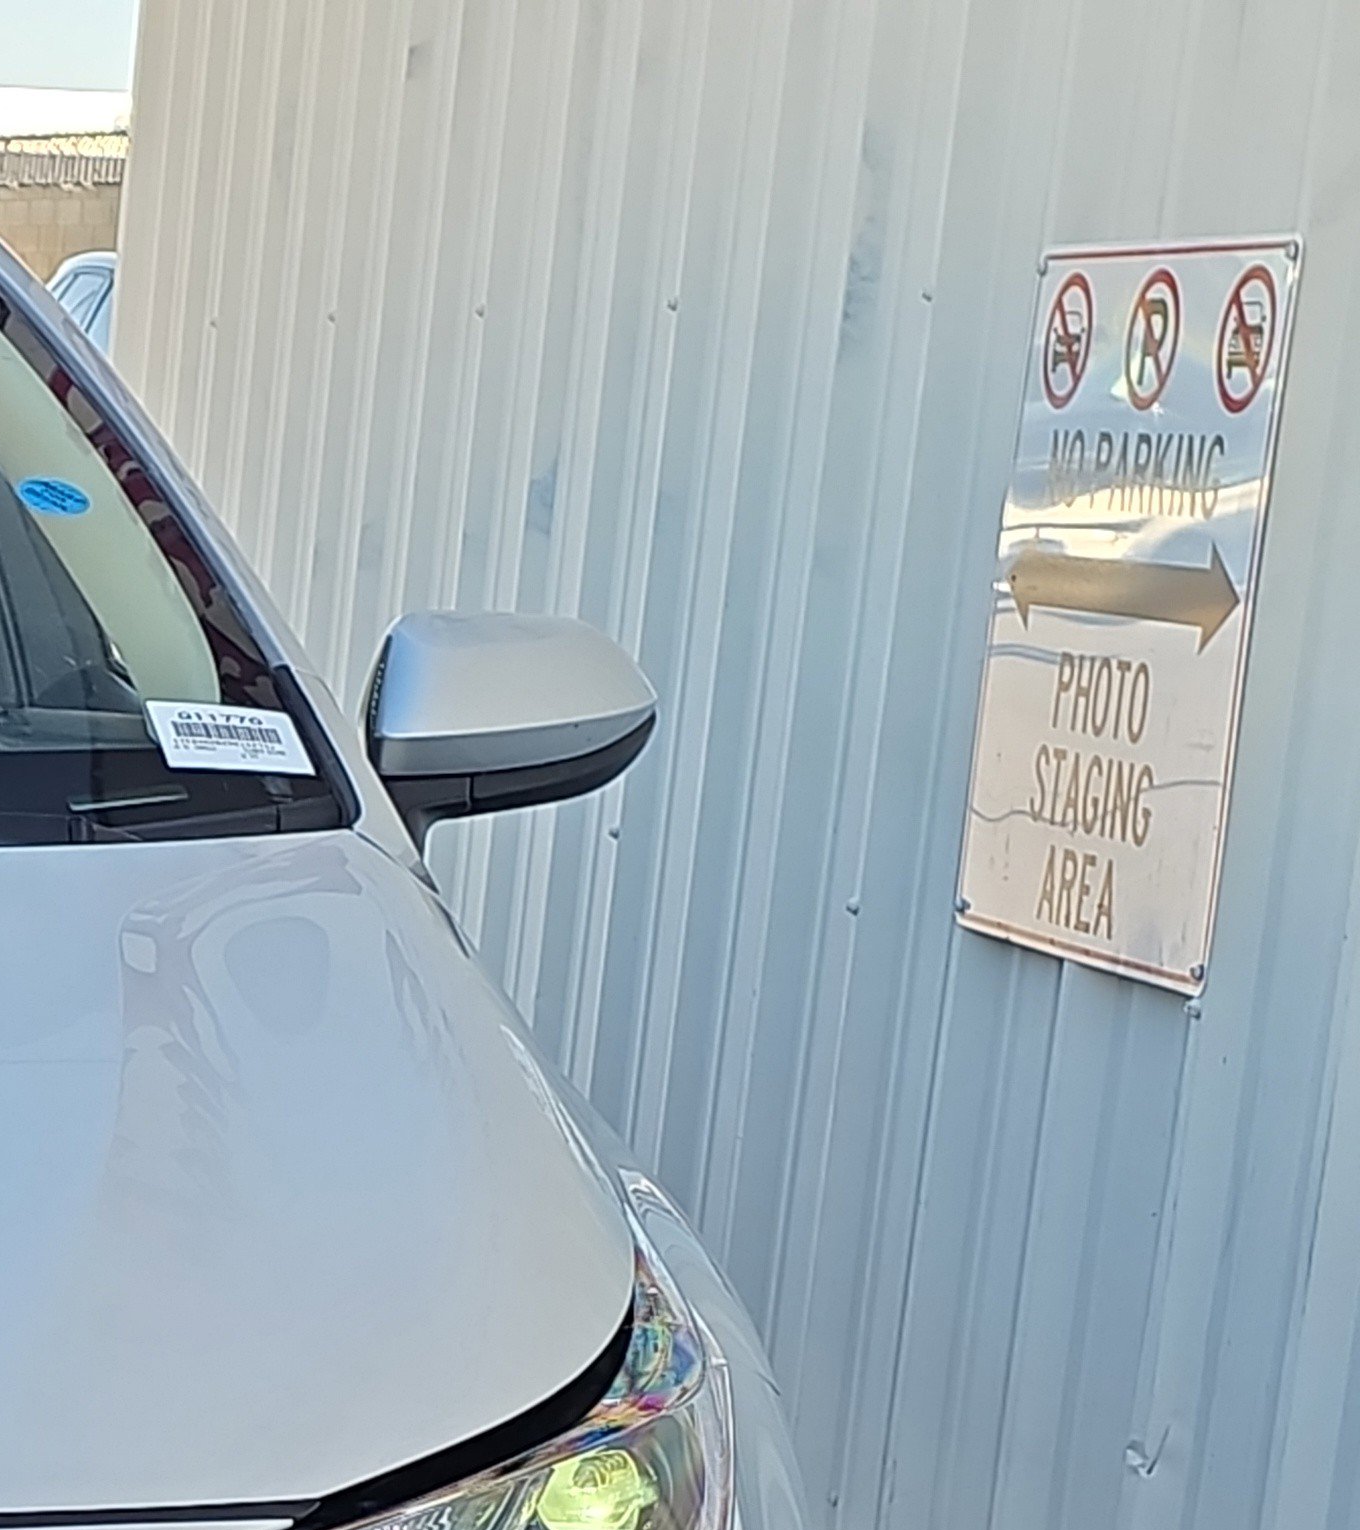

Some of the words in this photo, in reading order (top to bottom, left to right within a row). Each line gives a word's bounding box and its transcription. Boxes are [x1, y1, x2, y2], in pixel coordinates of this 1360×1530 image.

[1048, 430, 1084, 508] NO
[1090, 431, 1225, 520] PARKING
[1052, 652, 1150, 745] PHOTO
[1029, 744, 1155, 848] STAGING
[1035, 844, 1114, 941] AREA
